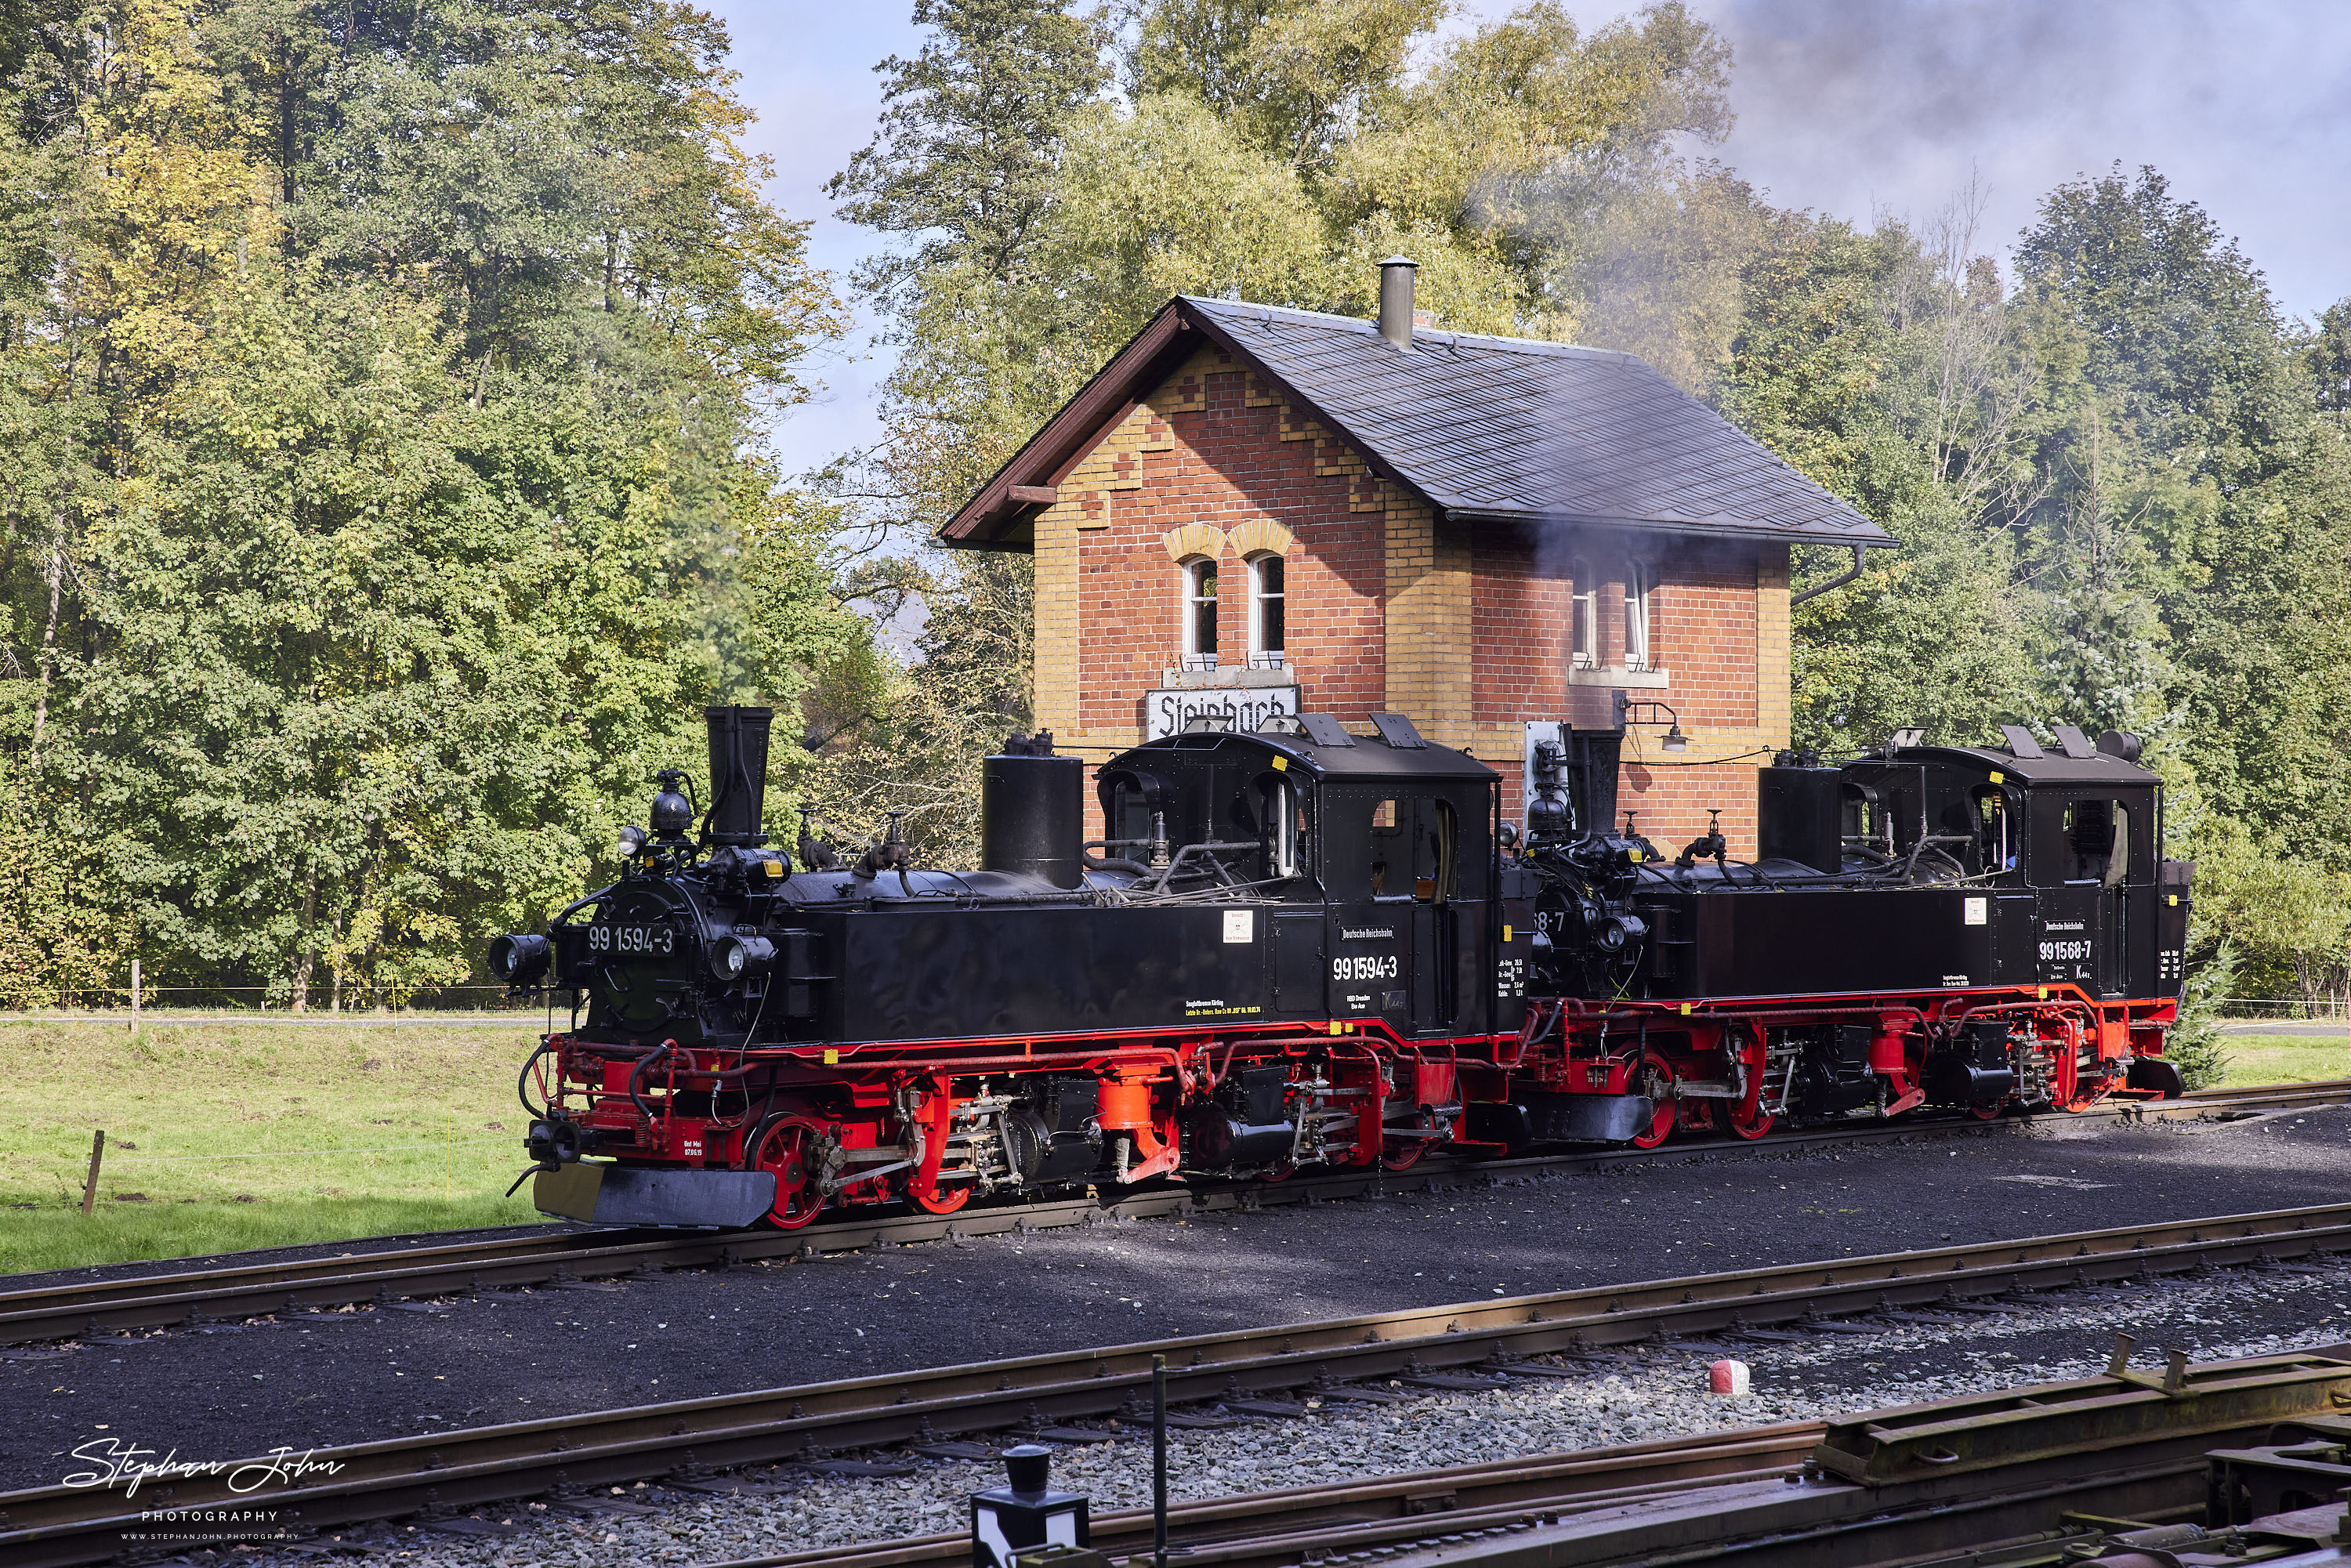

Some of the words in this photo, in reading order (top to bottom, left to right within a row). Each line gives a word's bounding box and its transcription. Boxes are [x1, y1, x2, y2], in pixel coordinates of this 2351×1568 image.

[1534, 911, 1564, 932] 8-7
[2046, 922, 2063, 931] Deutsche
[2064, 922, 2084, 930] Reichsbahn
[589, 925, 610, 951] 99
[614, 927, 673, 953] 1594-3
[1342, 929, 1365, 939] Deutsche
[1366, 928, 1393, 938] Reichsbahn
